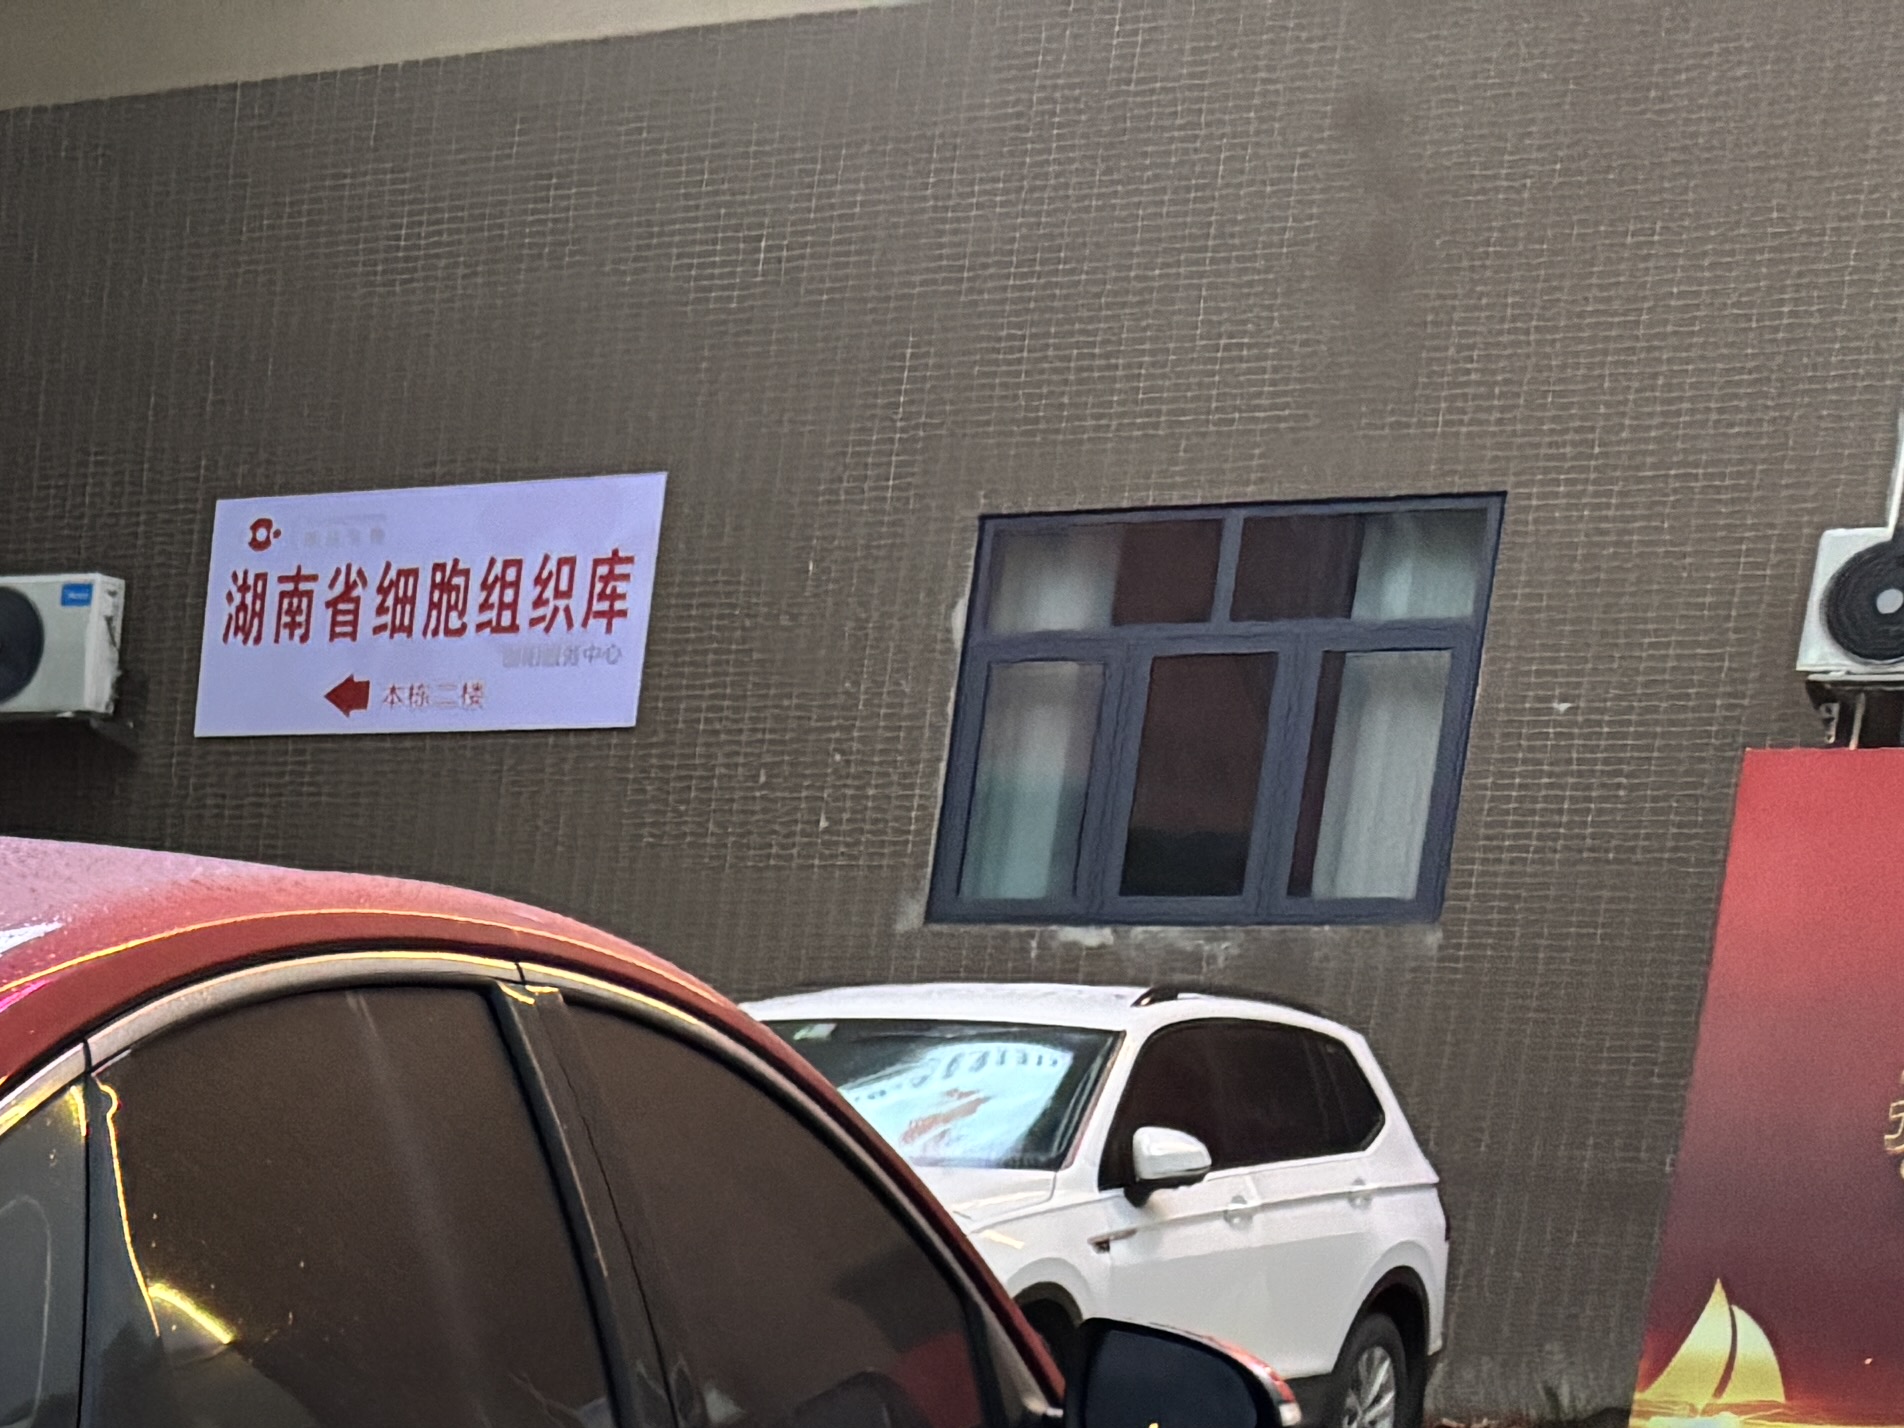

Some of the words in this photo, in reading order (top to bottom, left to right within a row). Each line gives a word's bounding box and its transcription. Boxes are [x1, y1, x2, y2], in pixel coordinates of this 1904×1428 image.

[221, 547, 636, 647] 湖南省细胞组织库
[382, 680, 487, 712] 本栋二楼
